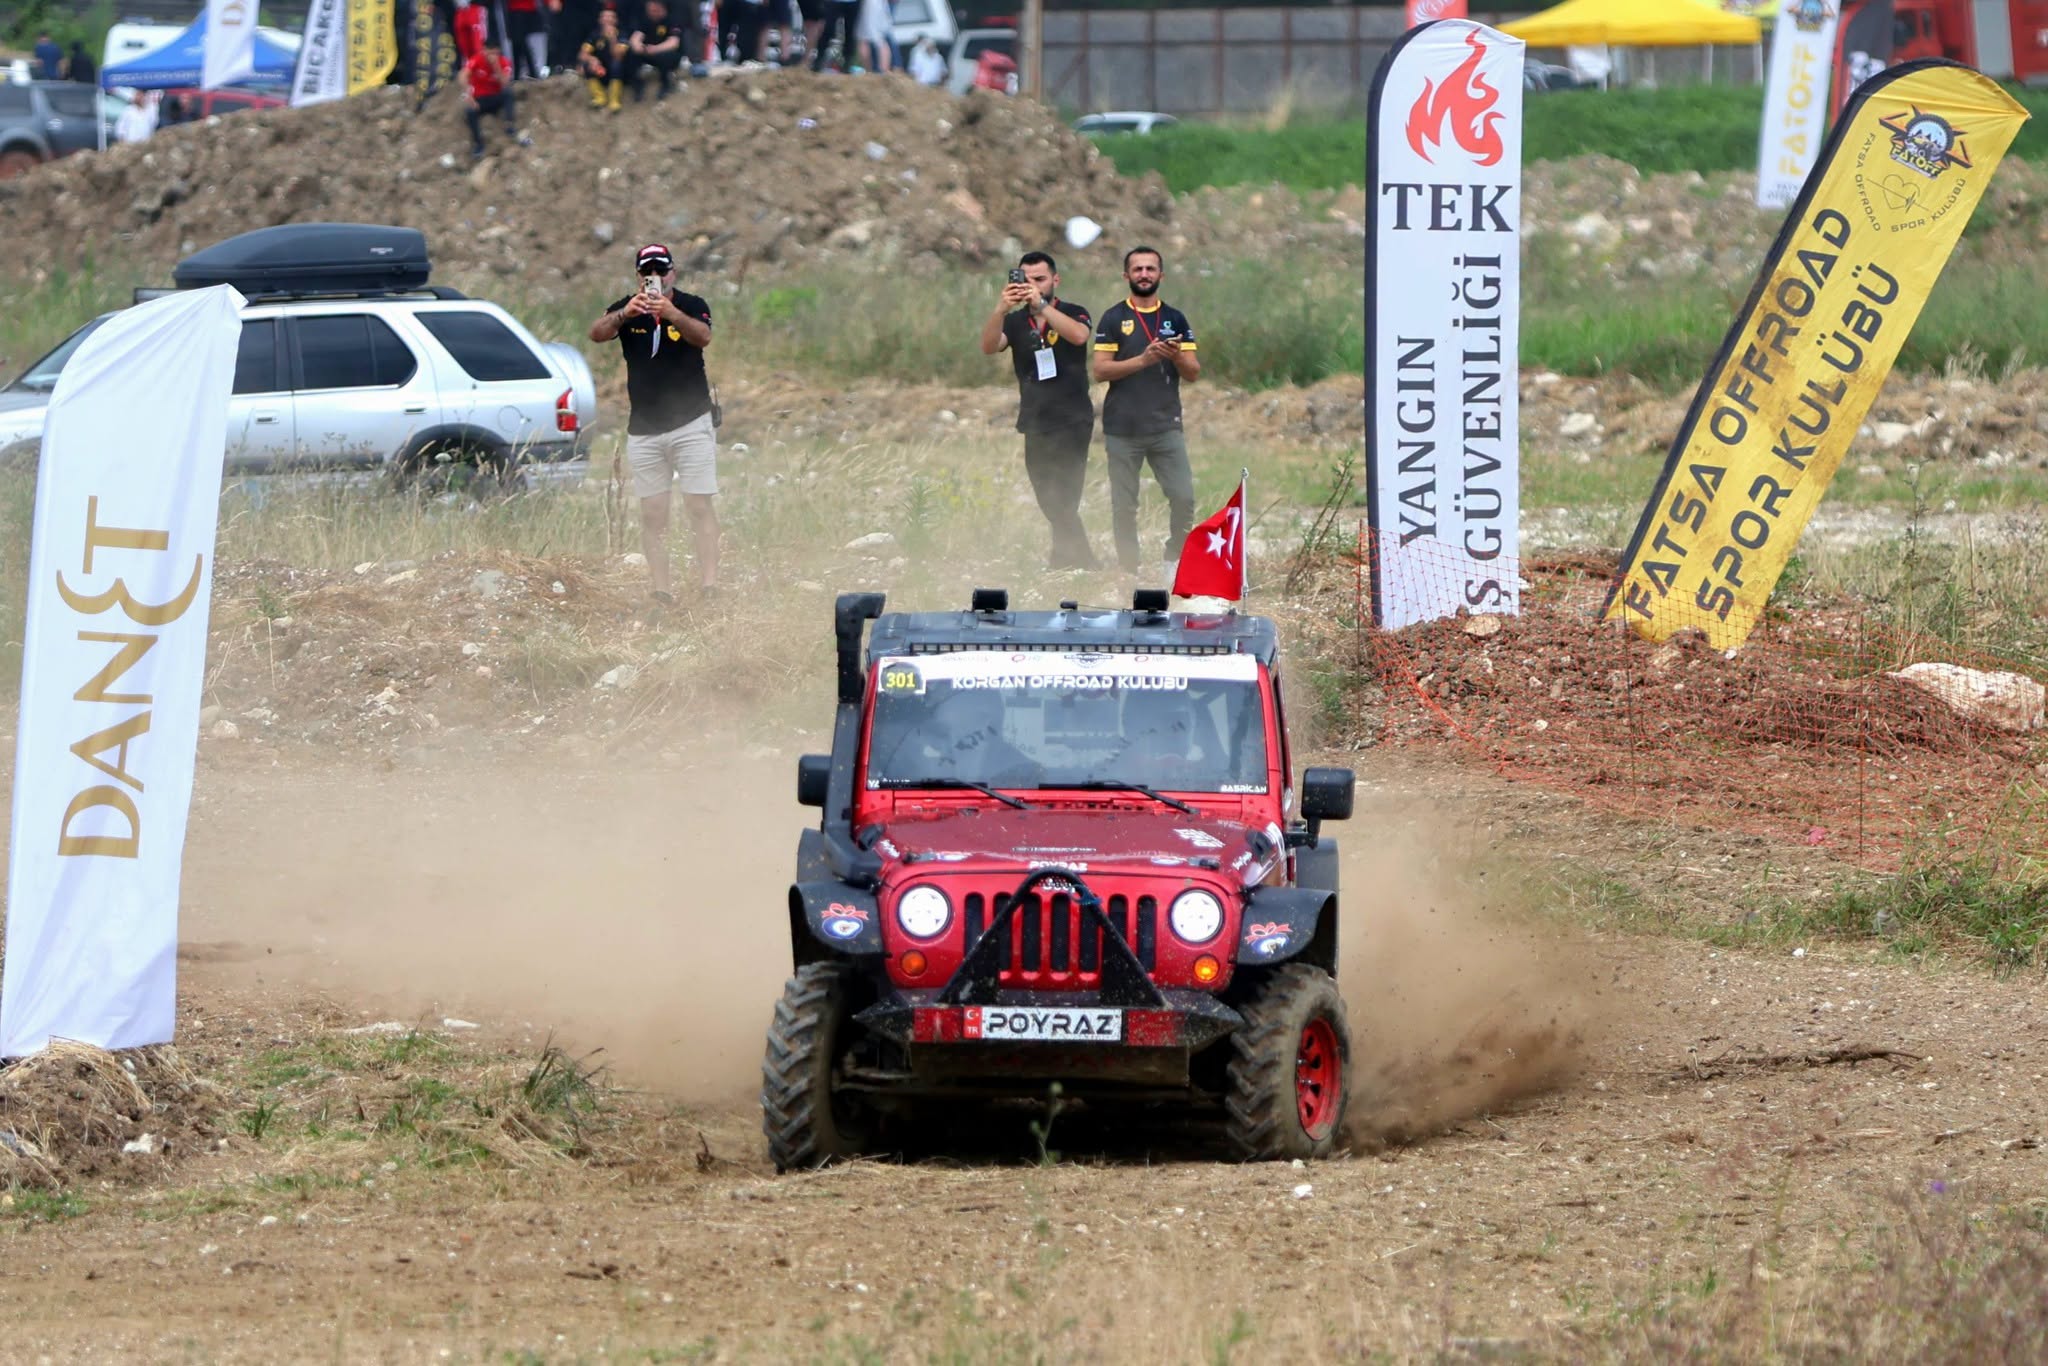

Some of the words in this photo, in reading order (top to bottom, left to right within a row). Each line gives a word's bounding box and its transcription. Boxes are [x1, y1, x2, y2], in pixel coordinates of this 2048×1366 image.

[1855, 132, 1877, 168] FATSA
[1382, 182, 1514, 232] TEK
[1854, 173, 1881, 232] OFFROAD
[1890, 219, 1926, 233] SPOR
[1451, 253, 1503, 561] GÜVENLİĞİ
[1624, 462, 1727, 620] FATSA
[1710, 207, 1851, 446] OFFROAD
[1397, 334, 1437, 549] YANGIN
[1694, 474, 1792, 622] SPOR
[1771, 263, 1899, 472] KULÜBÜ
[886, 672, 916, 688] 301
[952, 676, 1026, 689] KORGAN
[1030, 675, 1114, 690] OFFROAD
[966, 1026, 979, 1035] TR
[988, 1013, 1115, 1036] POYRAZ
